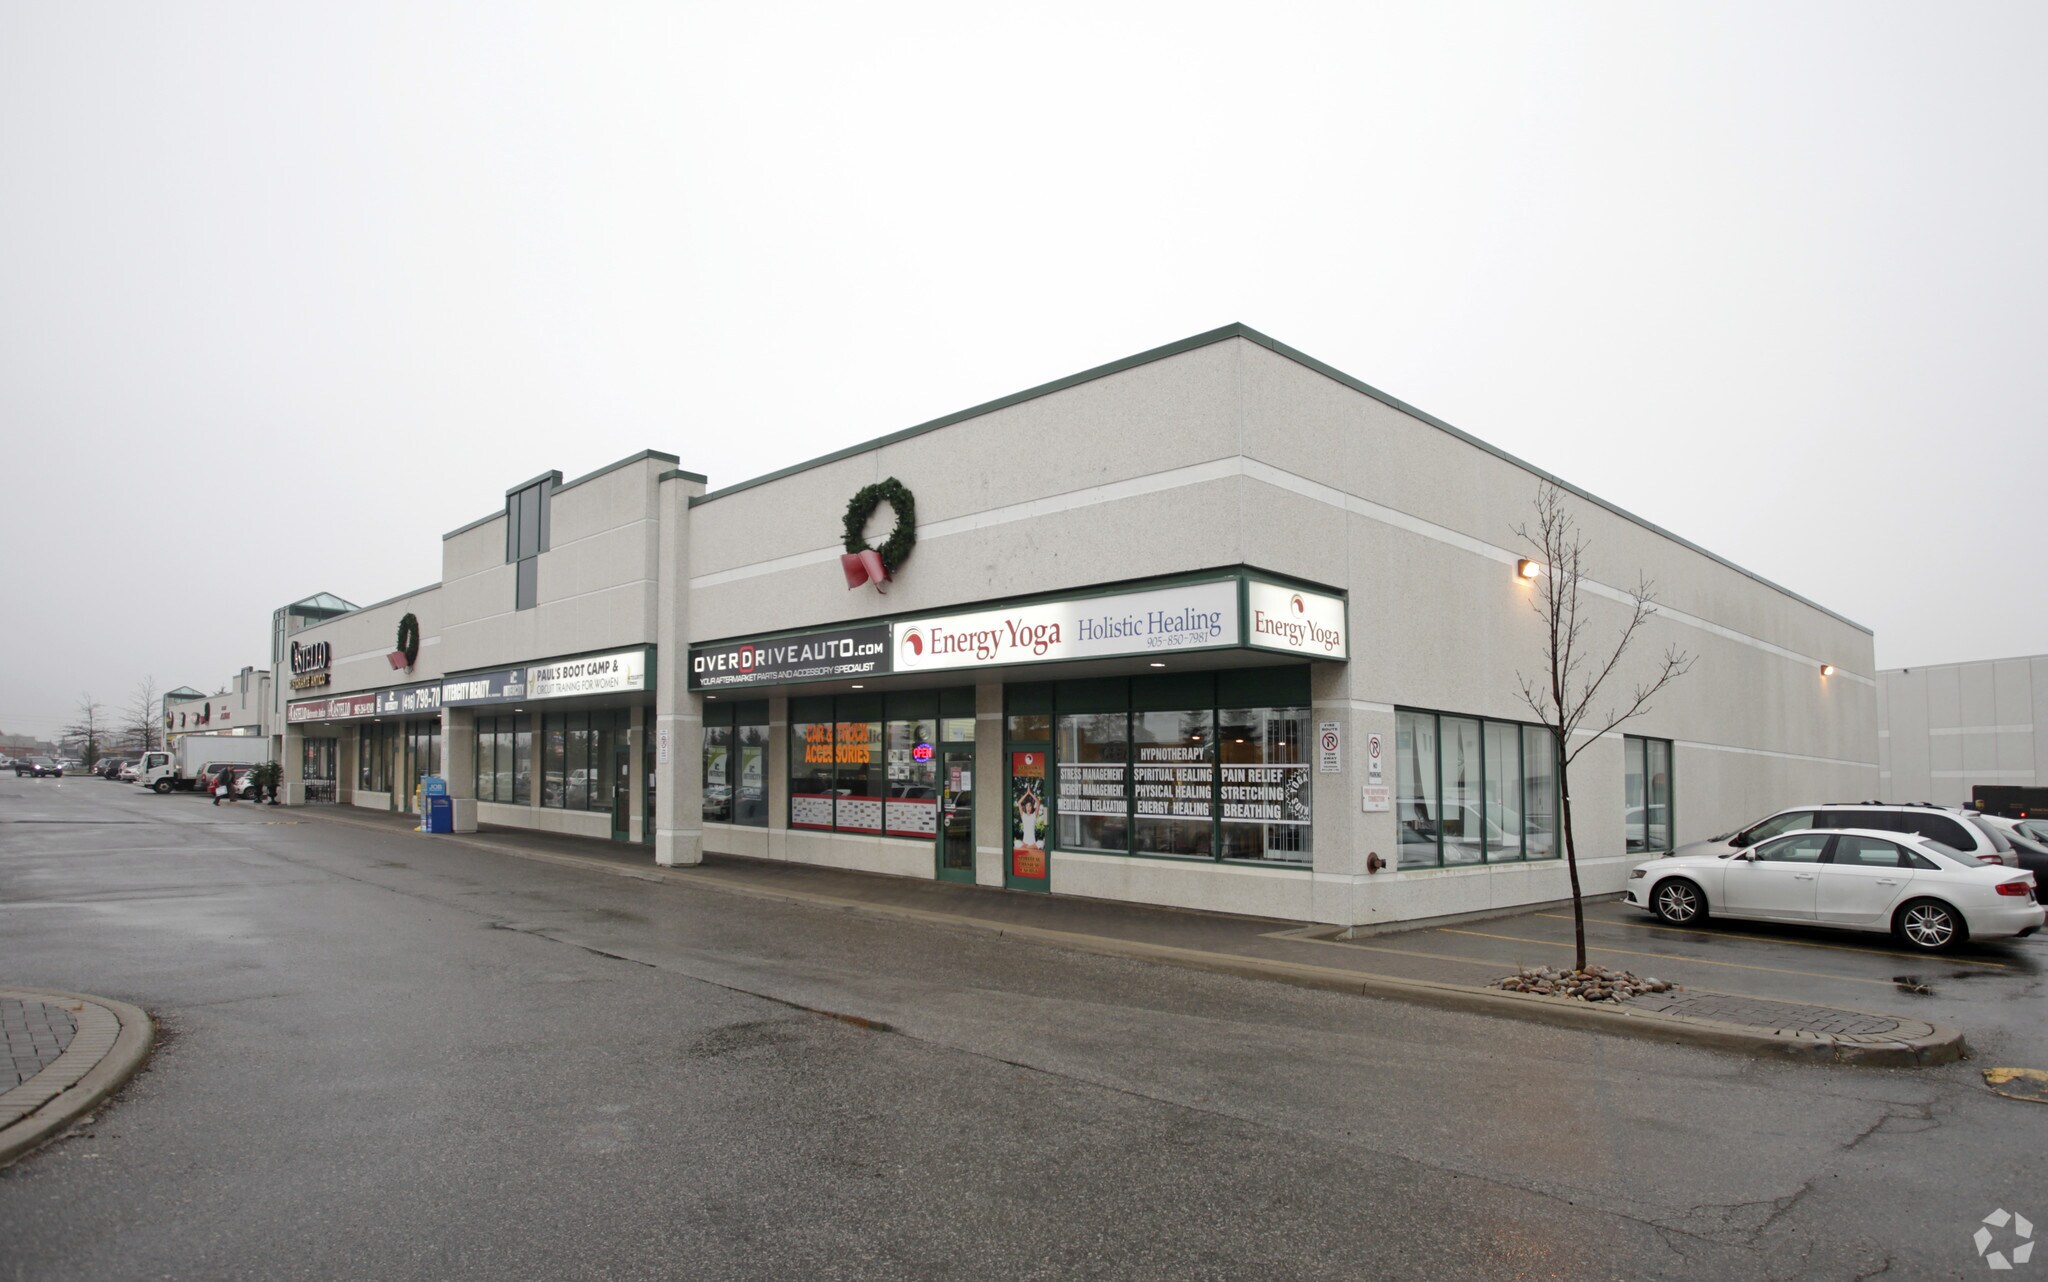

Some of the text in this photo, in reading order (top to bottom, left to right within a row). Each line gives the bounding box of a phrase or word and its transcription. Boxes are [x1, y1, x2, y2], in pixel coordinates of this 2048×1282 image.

[1078, 607, 1222, 641] Holistic Healing
[1254, 609, 1340, 652] Energy Yoga
[930, 619, 1061, 660] Energy Yoga
[1147, 631, 1209, 648] 905-850-7981
[536, 659, 619, 682] PAUL'S BOOT CAMP &
[757, 671, 777, 680] PARTS
[778, 669, 793, 679] AND
[793, 666, 833, 678] ACCESSORY
[834, 662, 875, 673] SPECIALIST
[581, 680, 594, 690] FOR
[595, 677, 619, 689] WOMEN
[806, 724, 825, 742] CAR
[836, 722, 869, 742] TRUCK
[913, 747, 932, 758] OPEN
[1141, 747, 1204, 760] HYPNOTHERAPY
[1060, 768, 1124, 781] STRESS MANAGEMENT
[1134, 768, 1212, 782] SPIRITUAL HEALING
[1221, 769, 1283, 782] PAIN RELIEF
[1060, 784, 1124, 797] WEIGHT MANAGEMENT
[1135, 784, 1212, 799] PHYSICAL HEALING
[1221, 786, 1284, 800] STRETCHING
[1058, 798, 1127, 812] MEDITATION RELAXATION
[1138, 801, 1209, 816] ENERGY HEALING
[1224, 803, 1281, 819] BREATHING
